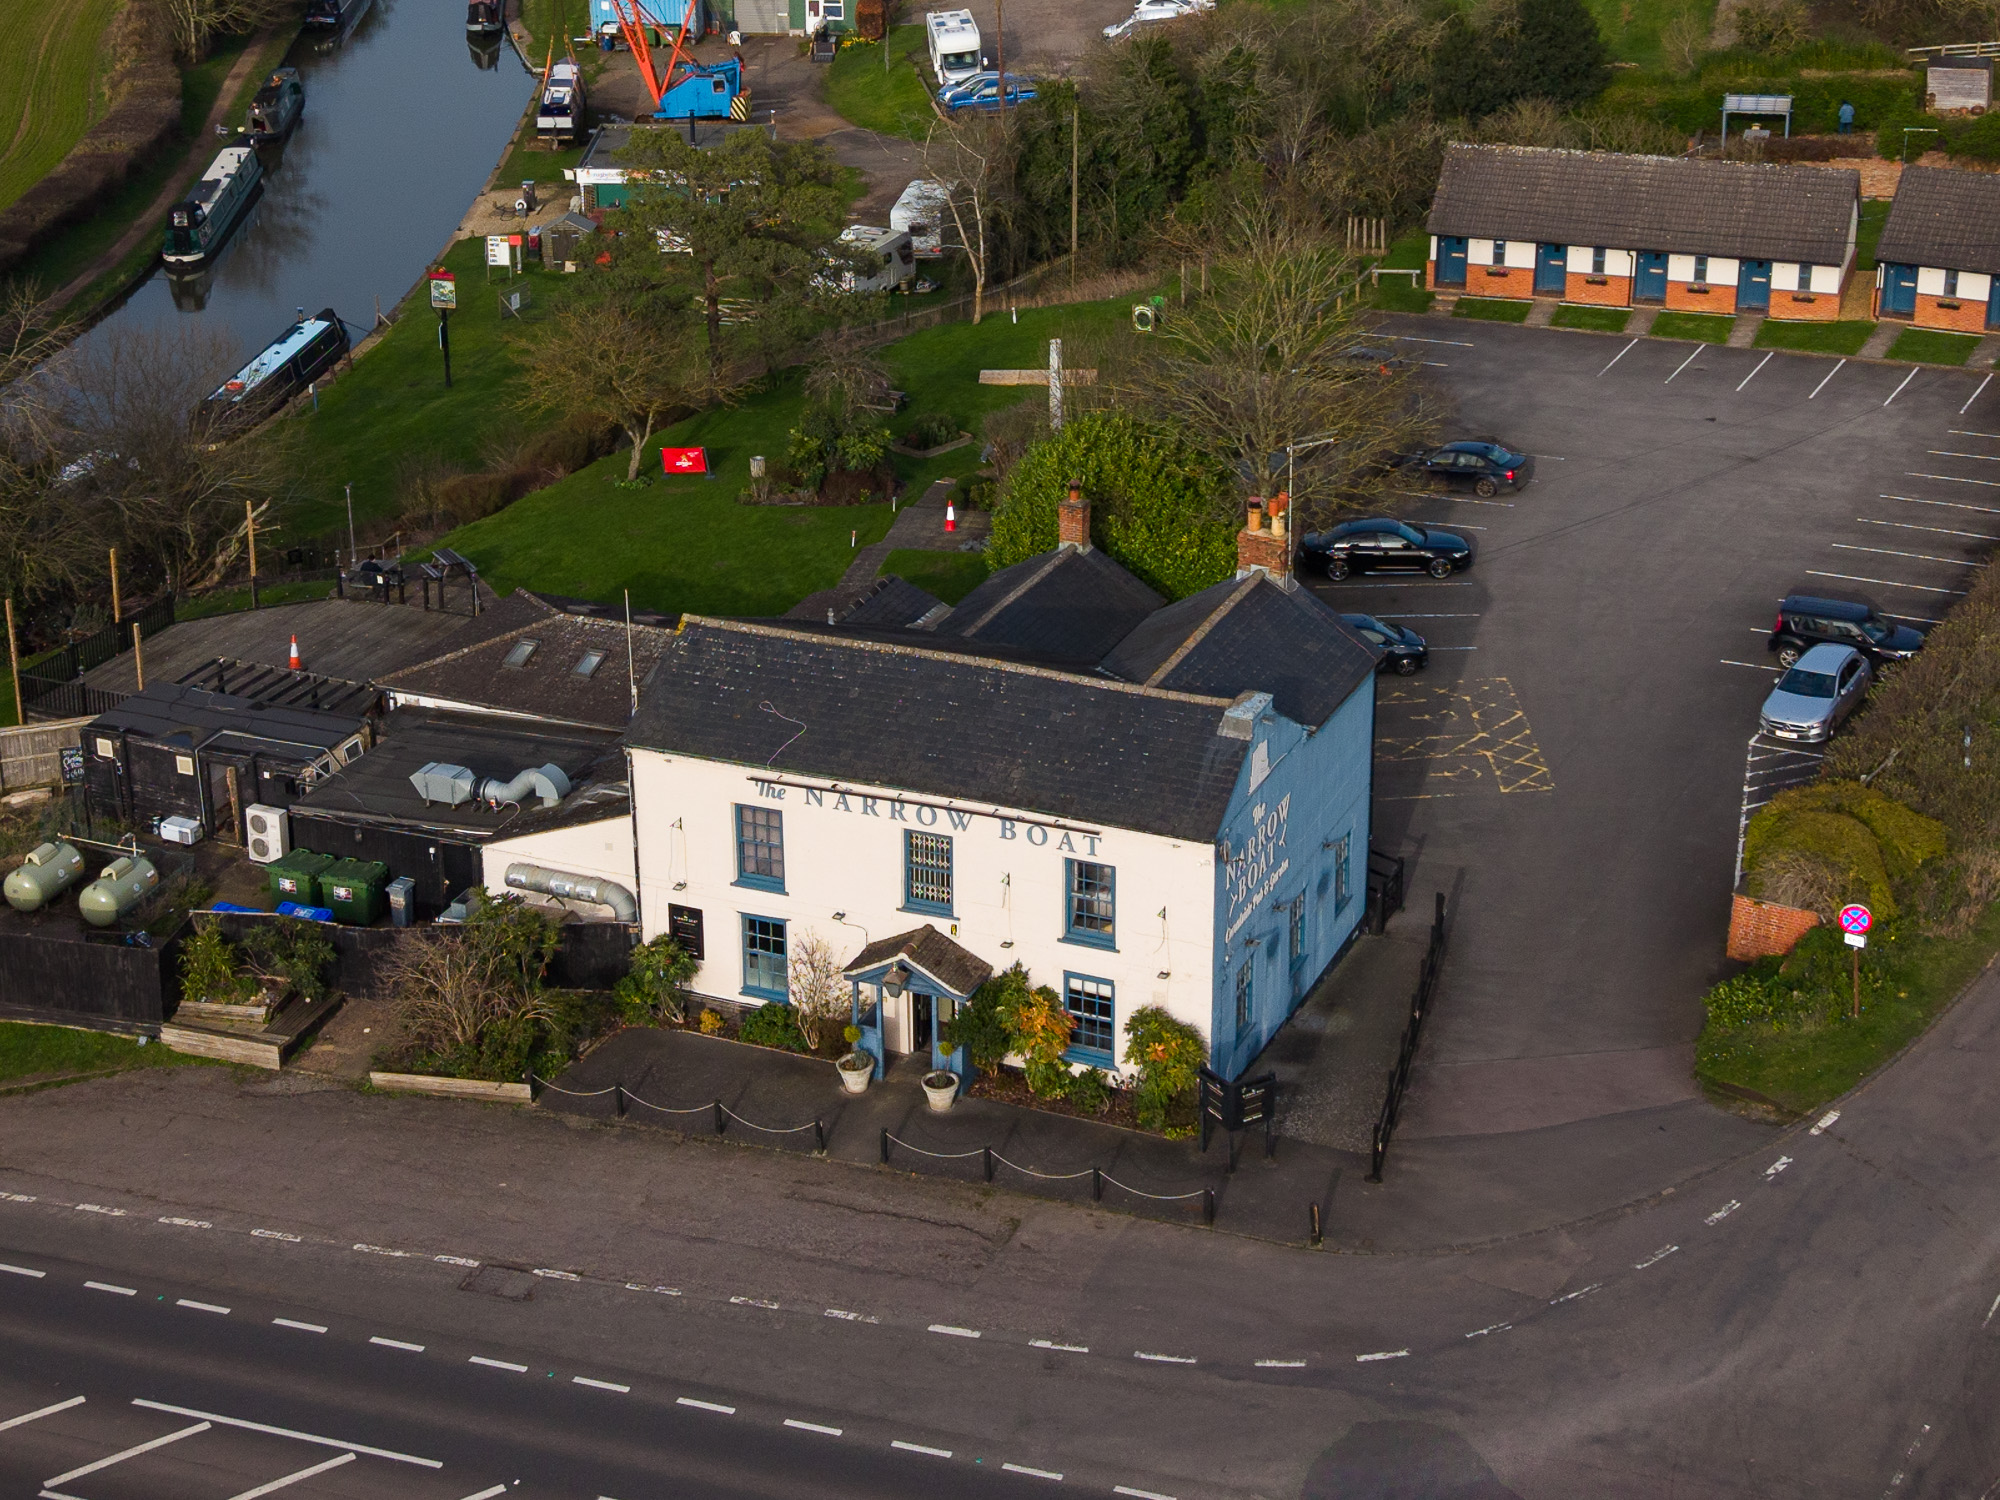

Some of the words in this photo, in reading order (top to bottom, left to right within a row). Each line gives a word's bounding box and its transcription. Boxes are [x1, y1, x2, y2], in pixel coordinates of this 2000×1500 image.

[755, 781, 786, 800] The
[805, 787, 973, 832] NARROW
[1000, 818, 1102, 857] BOAT
[1225, 791, 1291, 890] NARROW
[1253, 802, 1266, 826] The
[1238, 836, 1277, 904] BOAT
[1263, 880, 1270, 896] &
